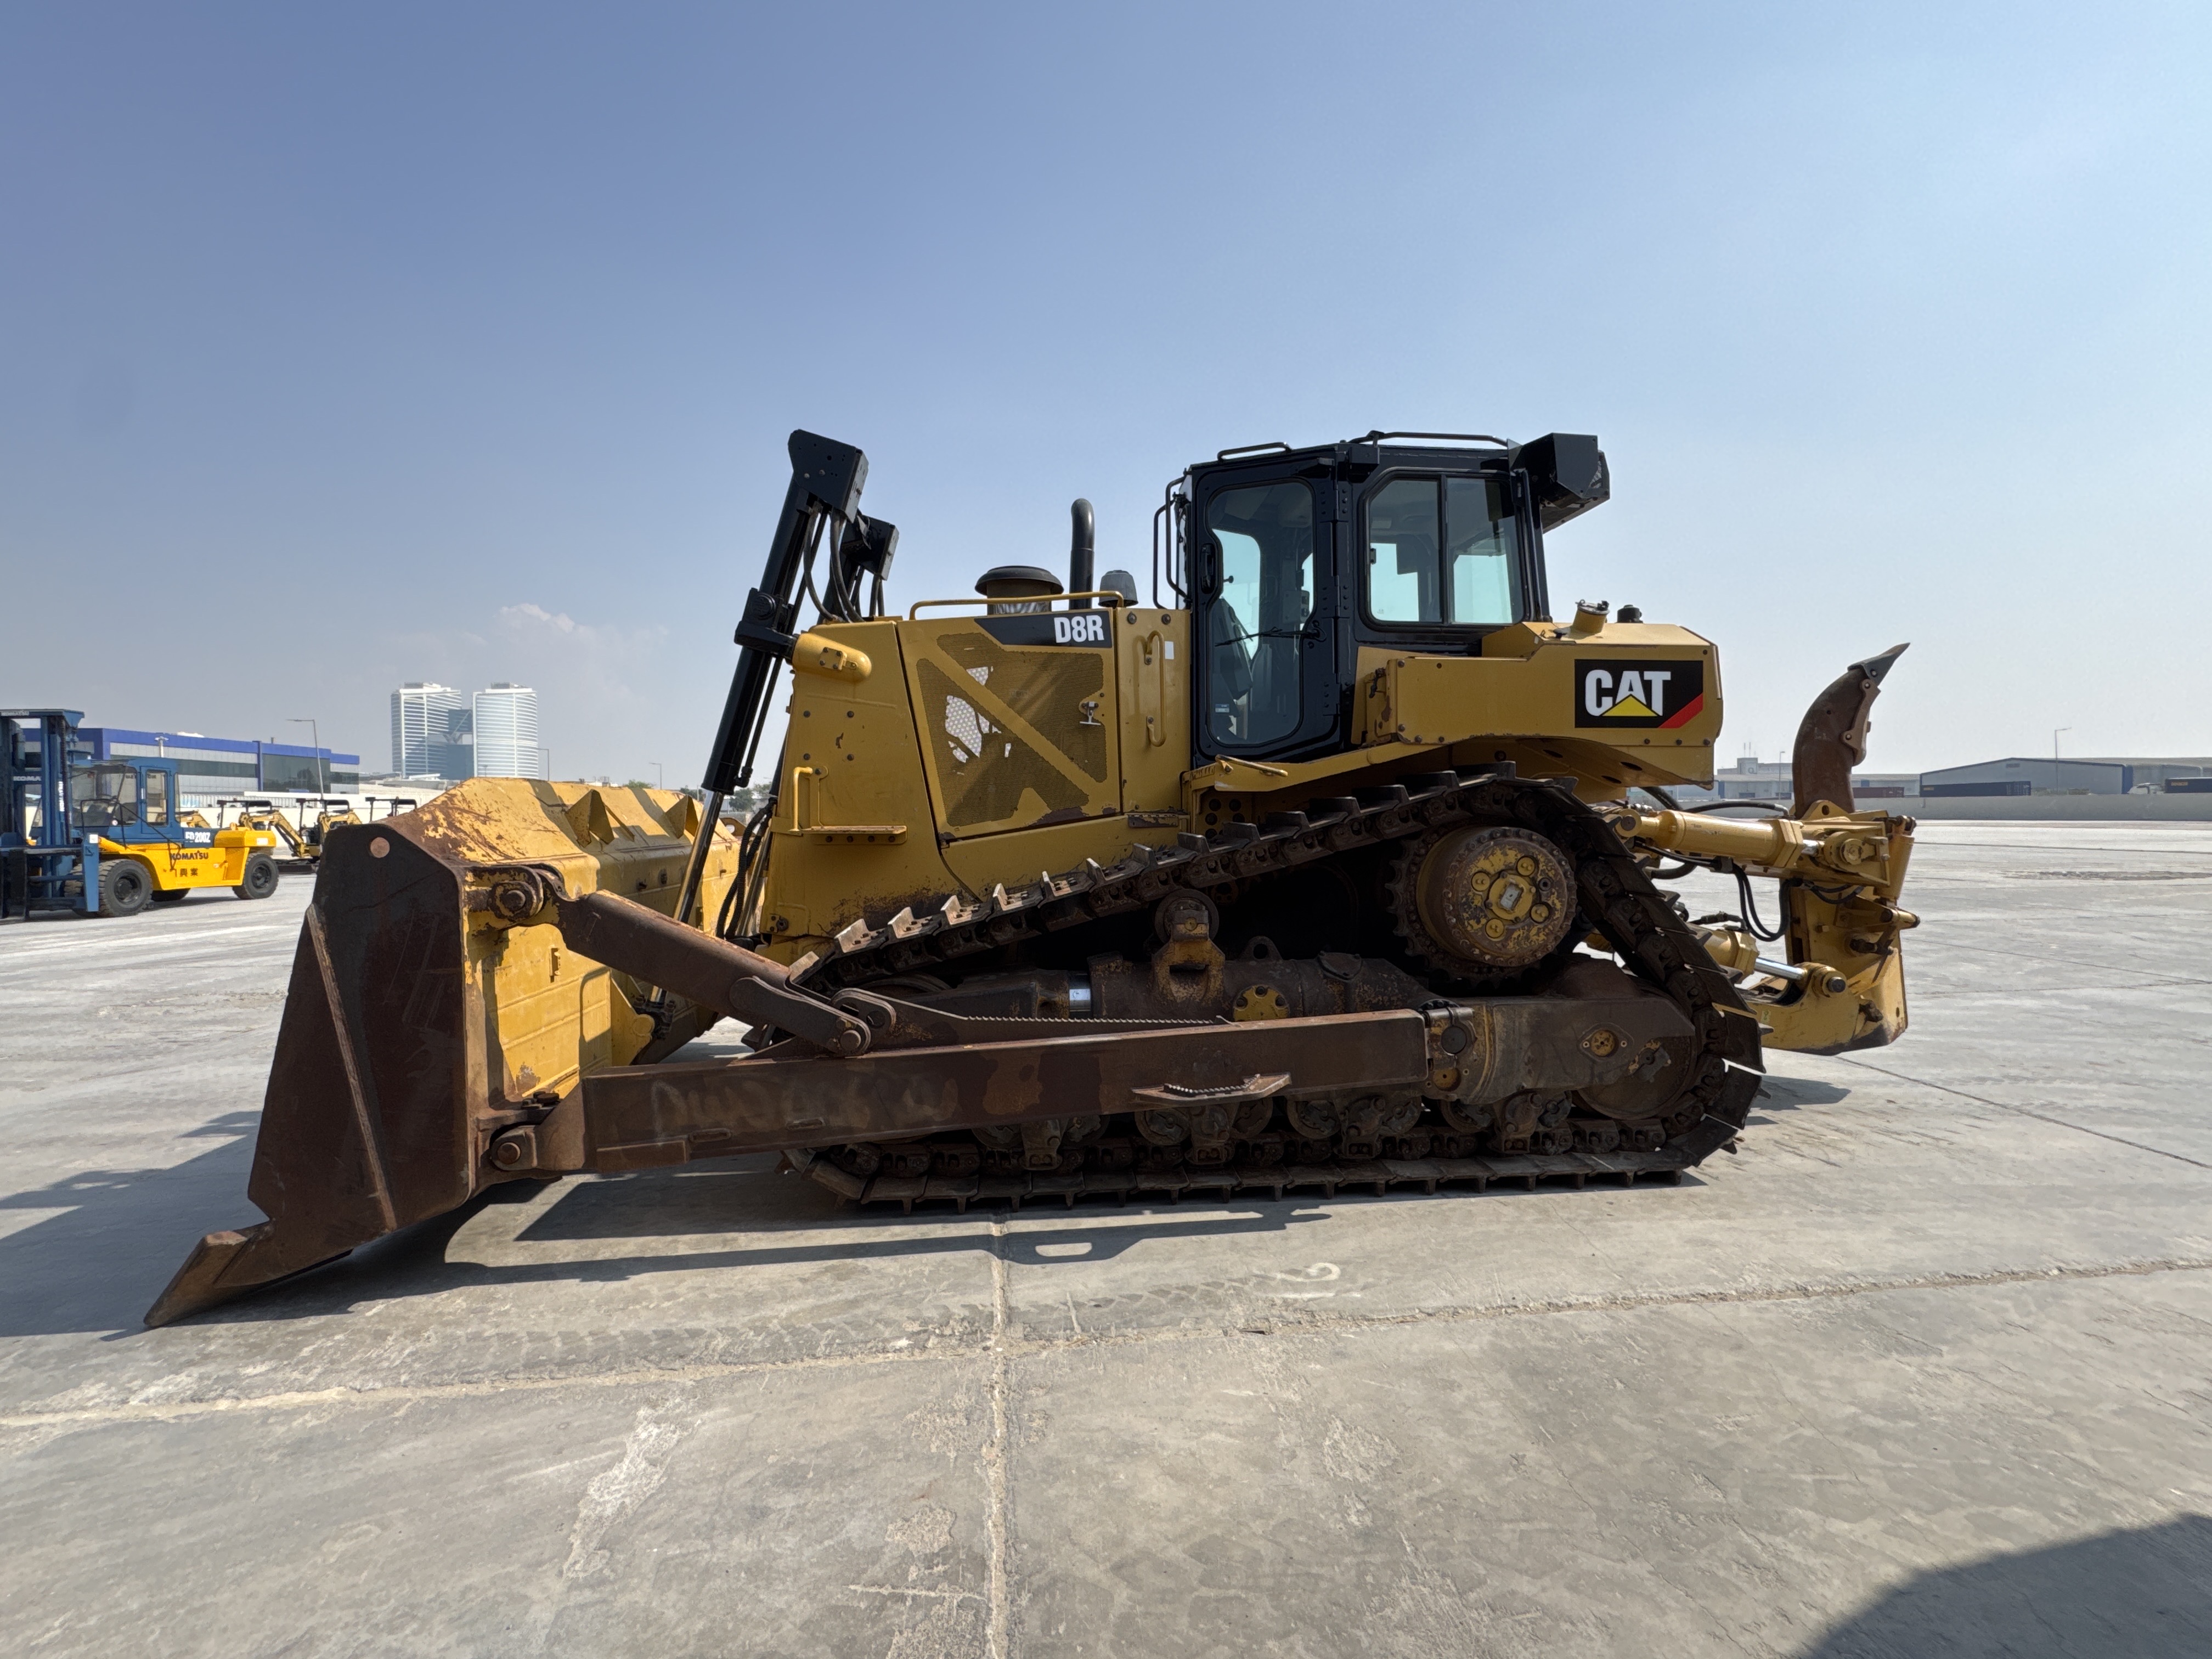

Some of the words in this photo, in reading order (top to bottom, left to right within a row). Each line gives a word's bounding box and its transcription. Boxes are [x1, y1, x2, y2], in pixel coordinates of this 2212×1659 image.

[1054, 615, 1104, 643] D8R
[1585, 669, 1671, 716] CAT
[170, 850, 209, 860] KOMATSU
